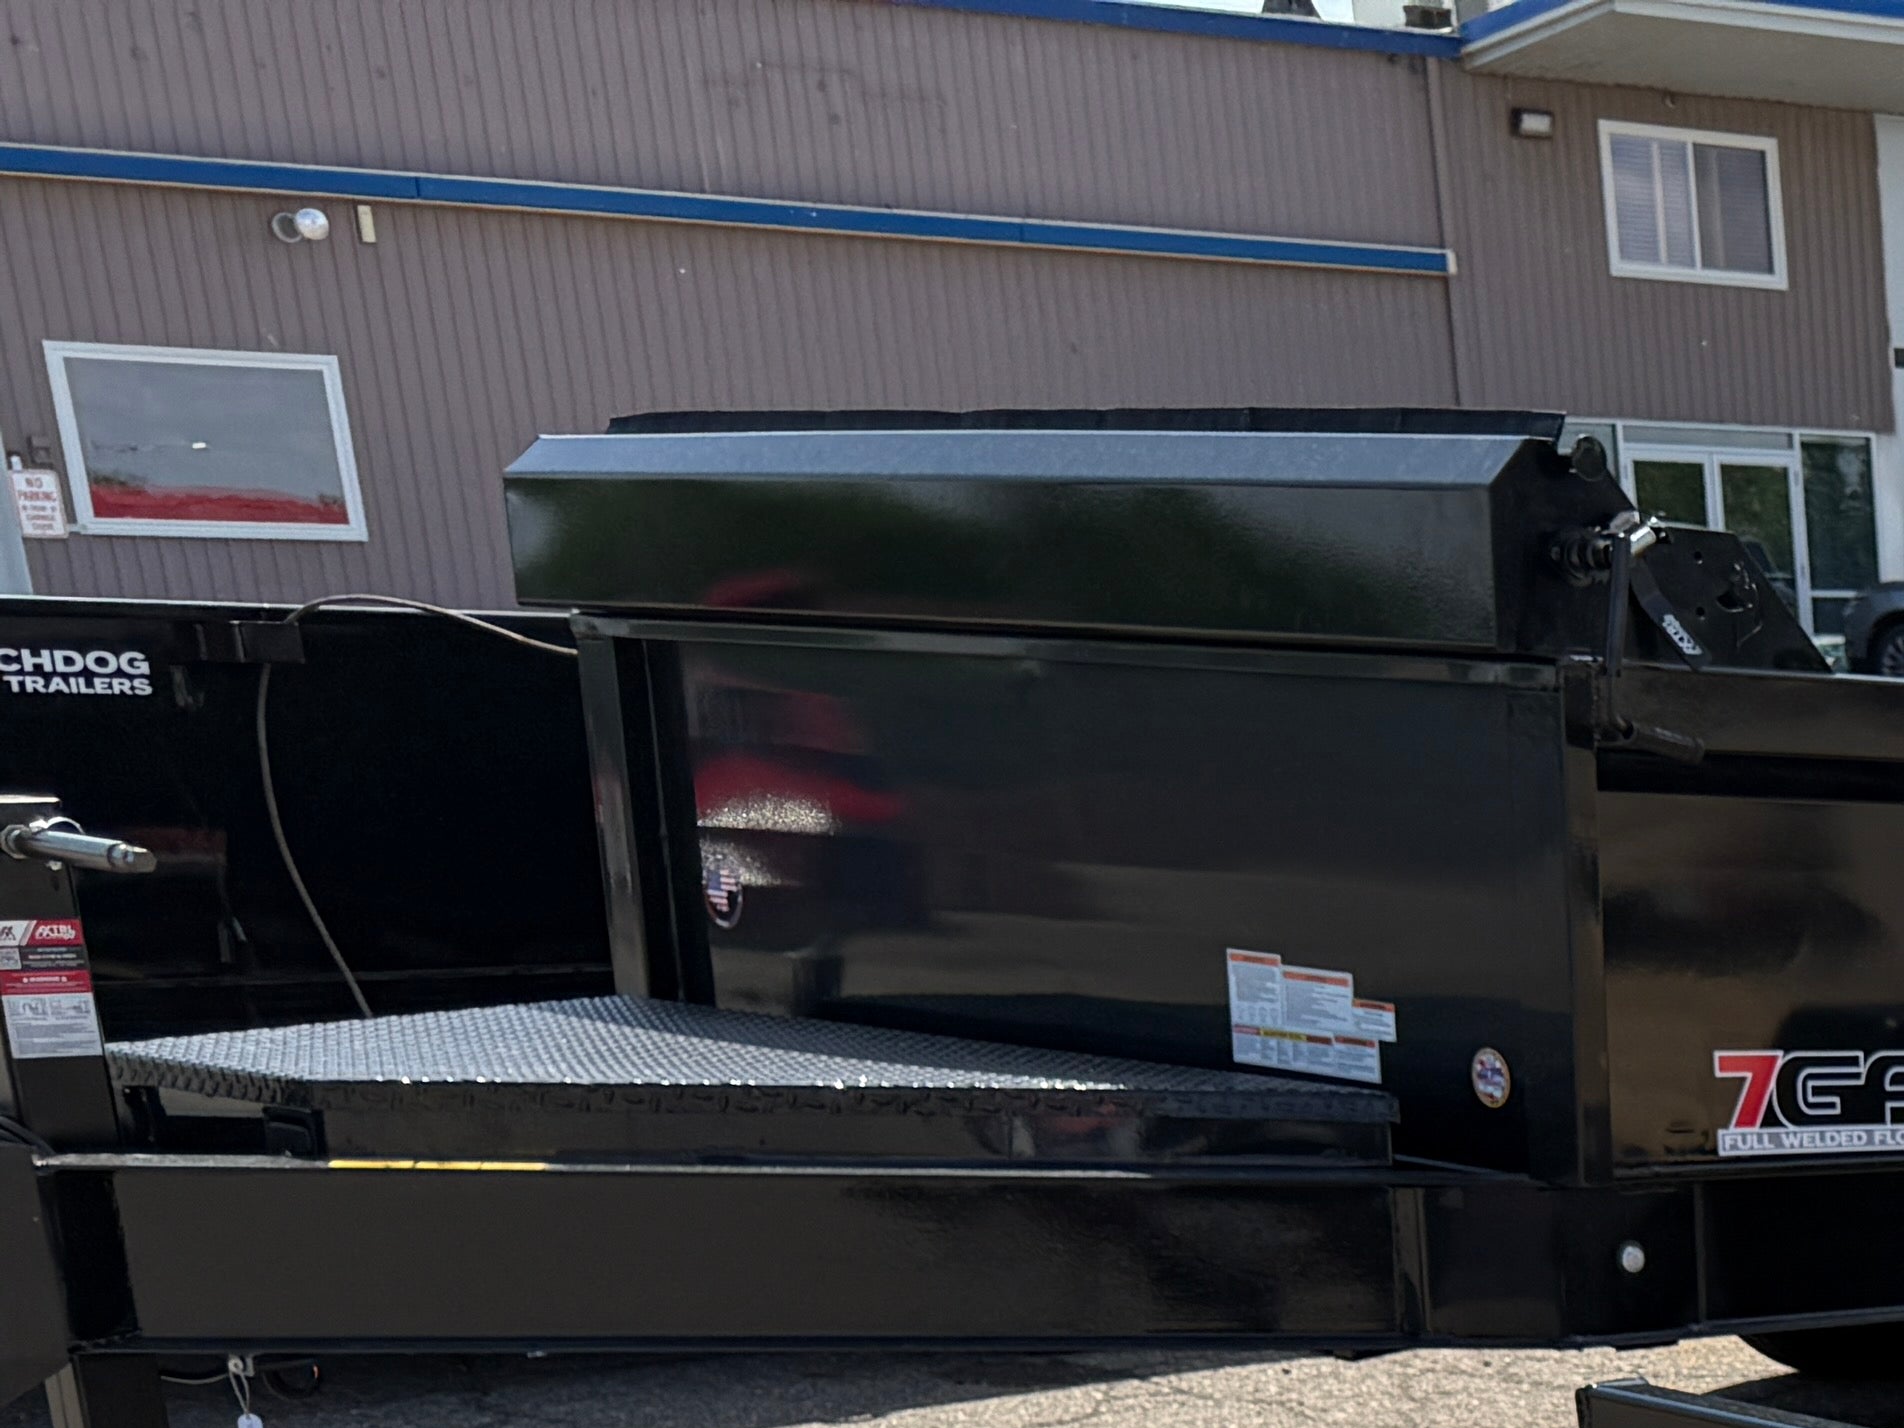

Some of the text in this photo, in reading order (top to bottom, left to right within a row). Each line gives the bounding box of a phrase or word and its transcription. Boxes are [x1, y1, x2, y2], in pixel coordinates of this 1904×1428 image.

[2, 675, 153, 695] TRAILERS
[1724, 1132, 1775, 1149] FULL
[1780, 1130, 1868, 1148] WELDED
